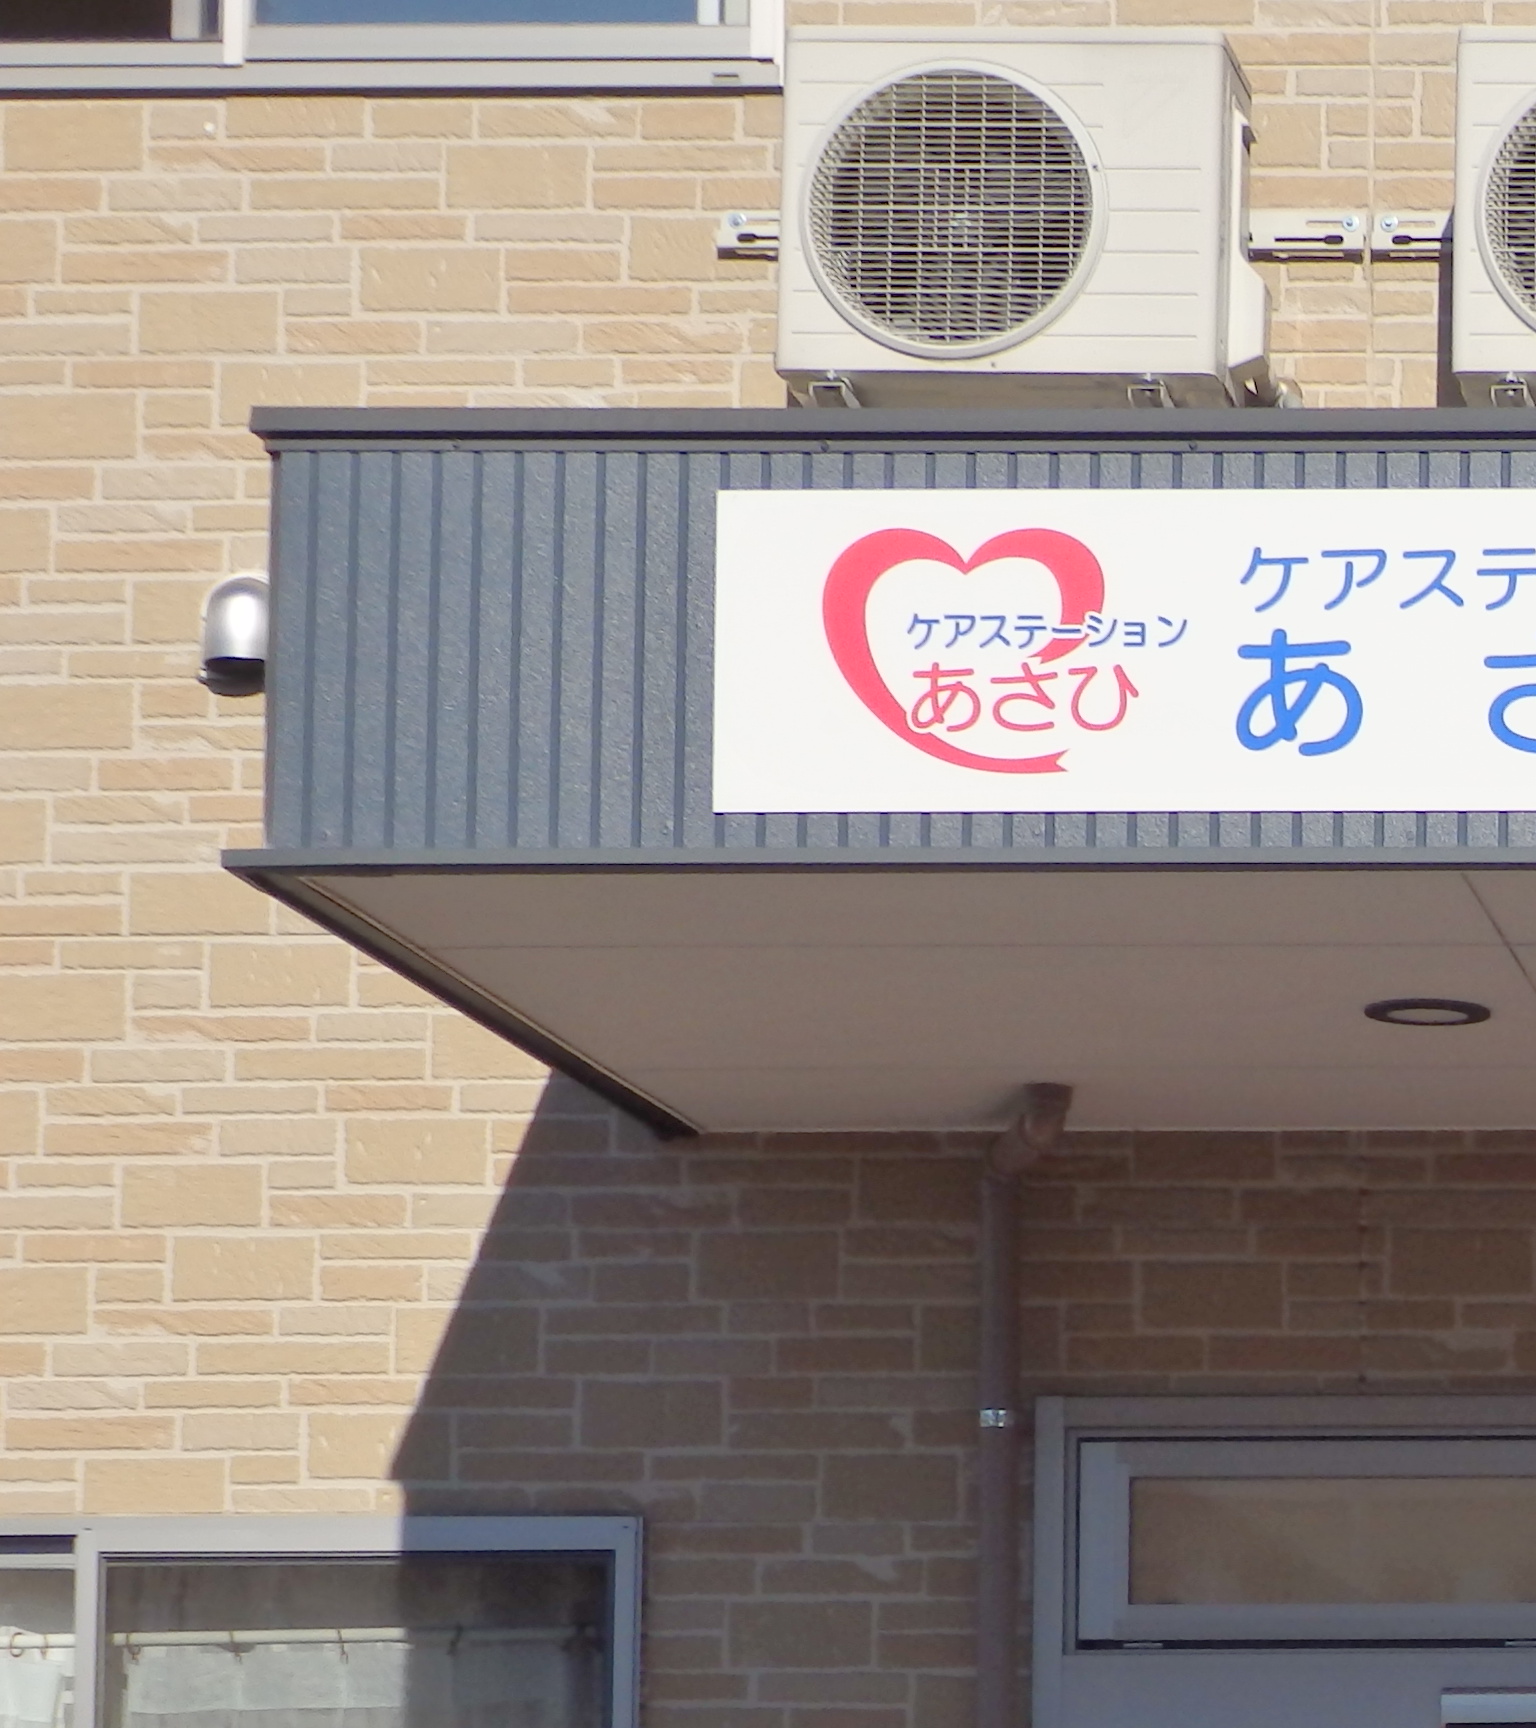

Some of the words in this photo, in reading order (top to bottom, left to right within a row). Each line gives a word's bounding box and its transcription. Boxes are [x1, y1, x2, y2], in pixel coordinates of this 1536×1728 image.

[907, 614, 1188, 648] ケアステーション
[909, 661, 1138, 735] あさひ
